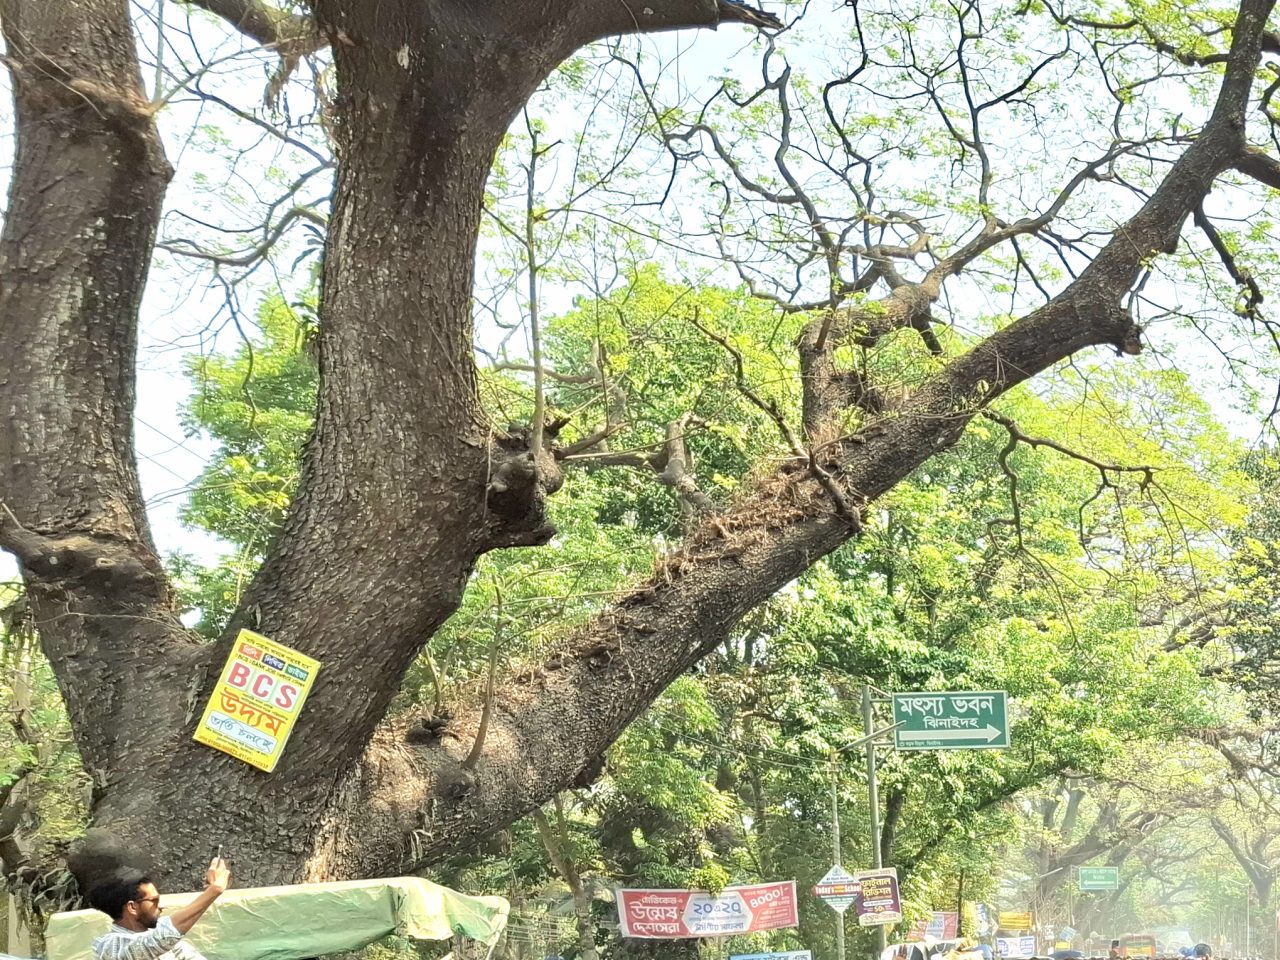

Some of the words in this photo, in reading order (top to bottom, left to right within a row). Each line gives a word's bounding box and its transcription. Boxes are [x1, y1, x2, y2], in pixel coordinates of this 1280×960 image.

[228, 662, 297, 708] BCS
[220, 687, 286, 736] উদ্যম
[897, 697, 946, 716] মৎস্য
[950, 696, 995, 715] ভবন
[923, 715, 979, 728] ঝিনাইদহ
[629, 901, 678, 920] উন্মেষ
[633, 922, 680, 935] দেশসেরা
